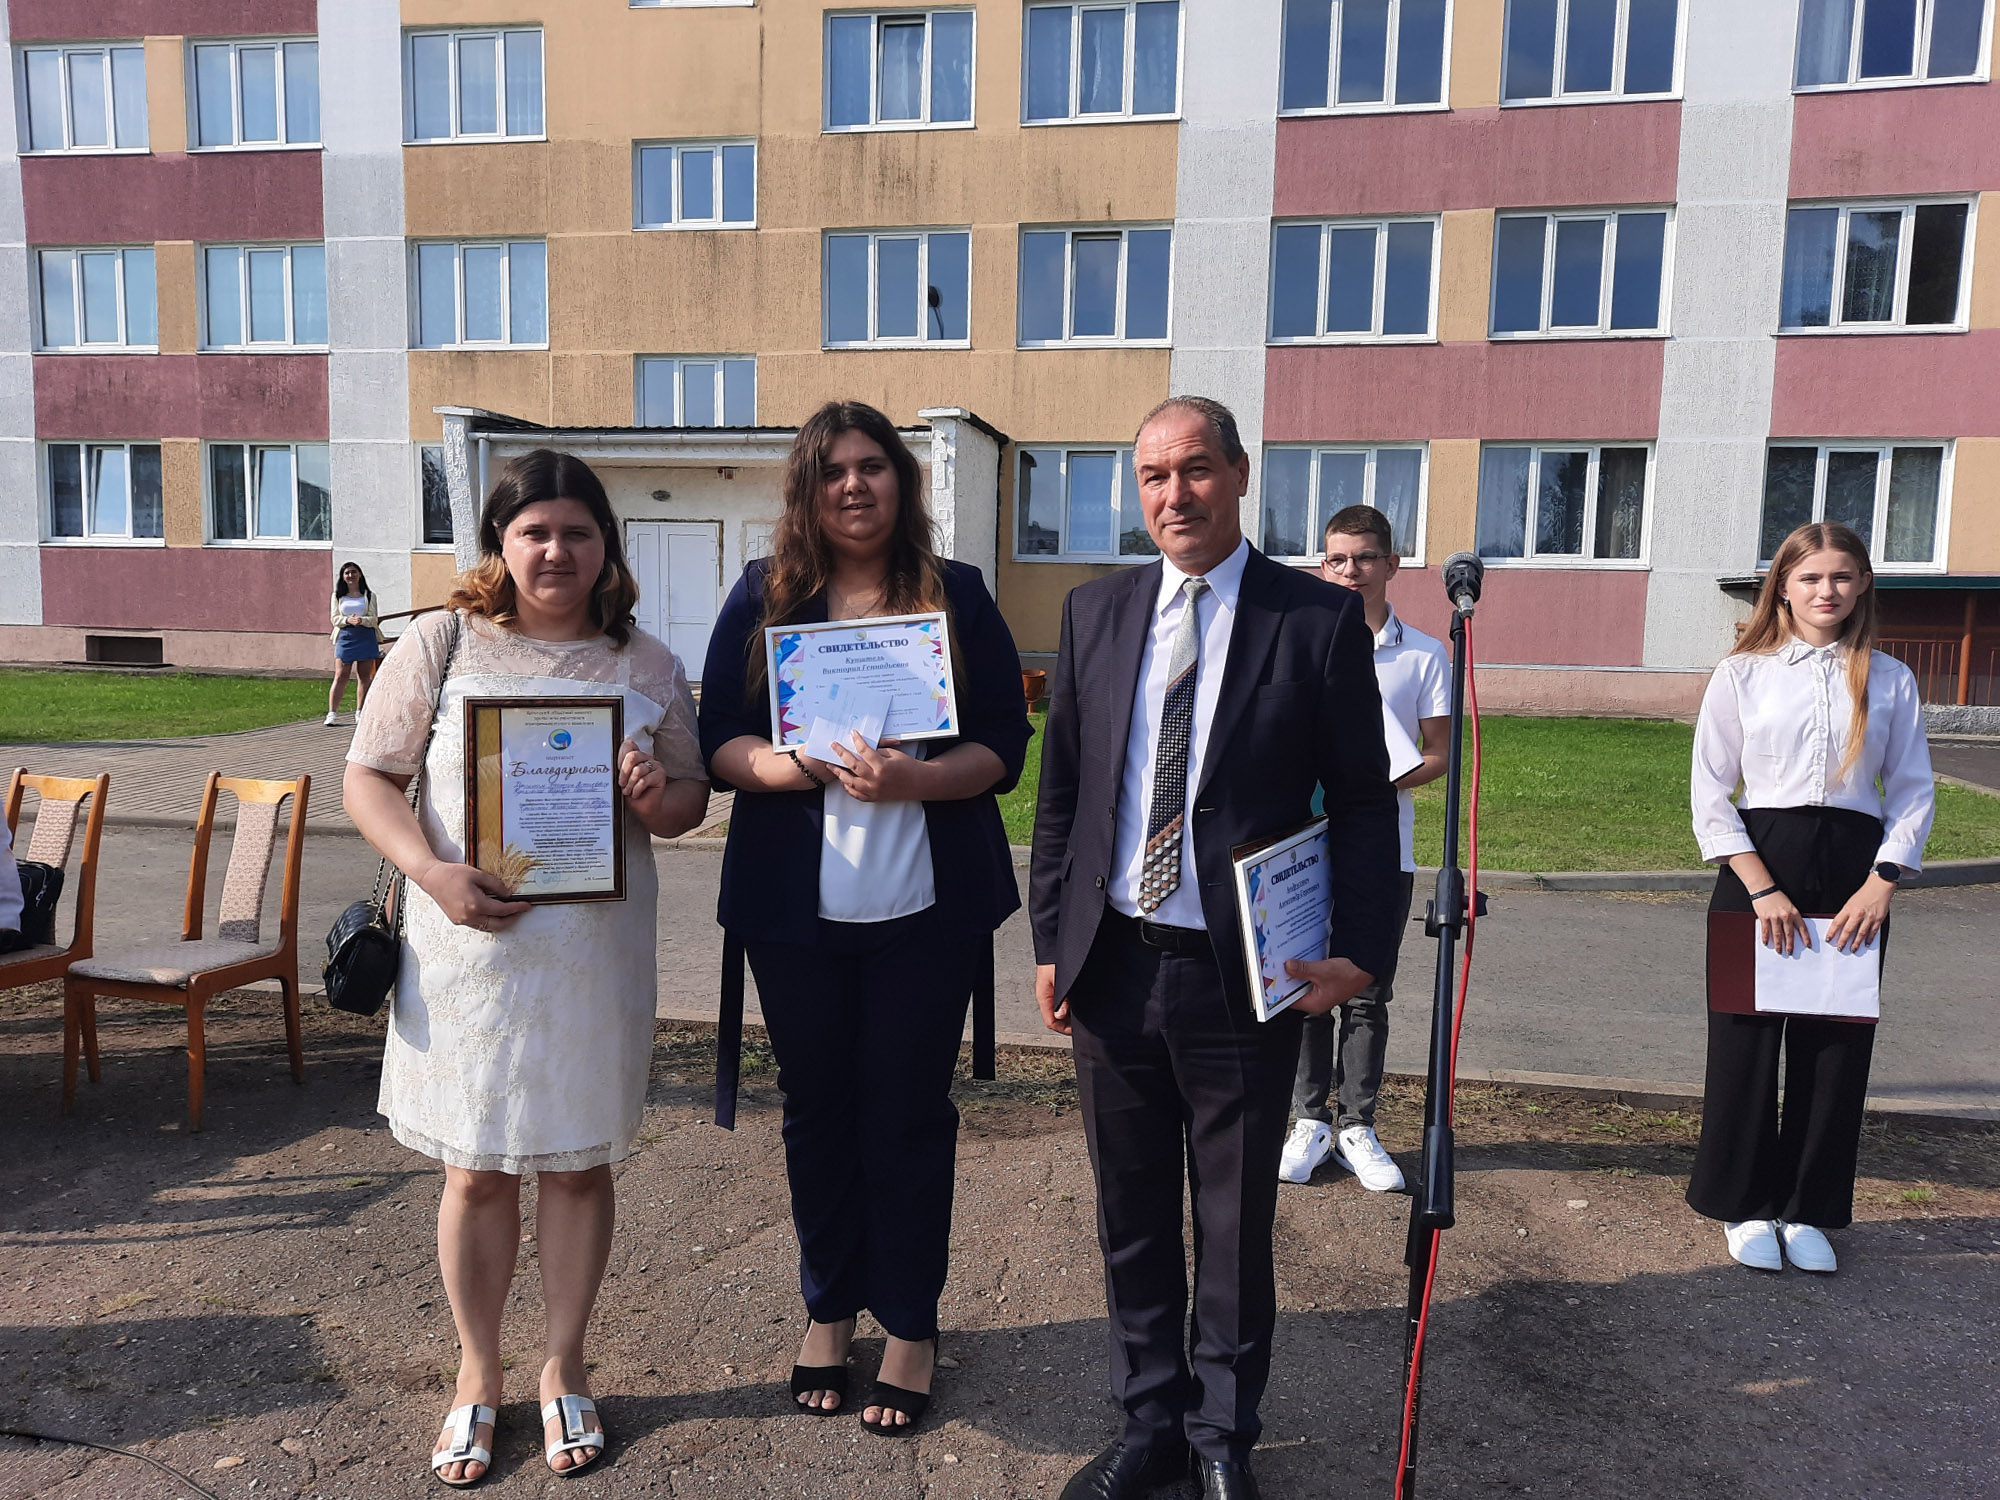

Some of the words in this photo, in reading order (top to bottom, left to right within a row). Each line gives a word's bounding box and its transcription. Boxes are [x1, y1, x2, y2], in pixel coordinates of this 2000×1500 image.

[818, 638, 909, 654] СВИДЕТЕЛЬСТВО
[509, 761, 610, 783] Благодарность
[1271, 854, 1319, 885] СВИДЕТЕЛЬСТВО
